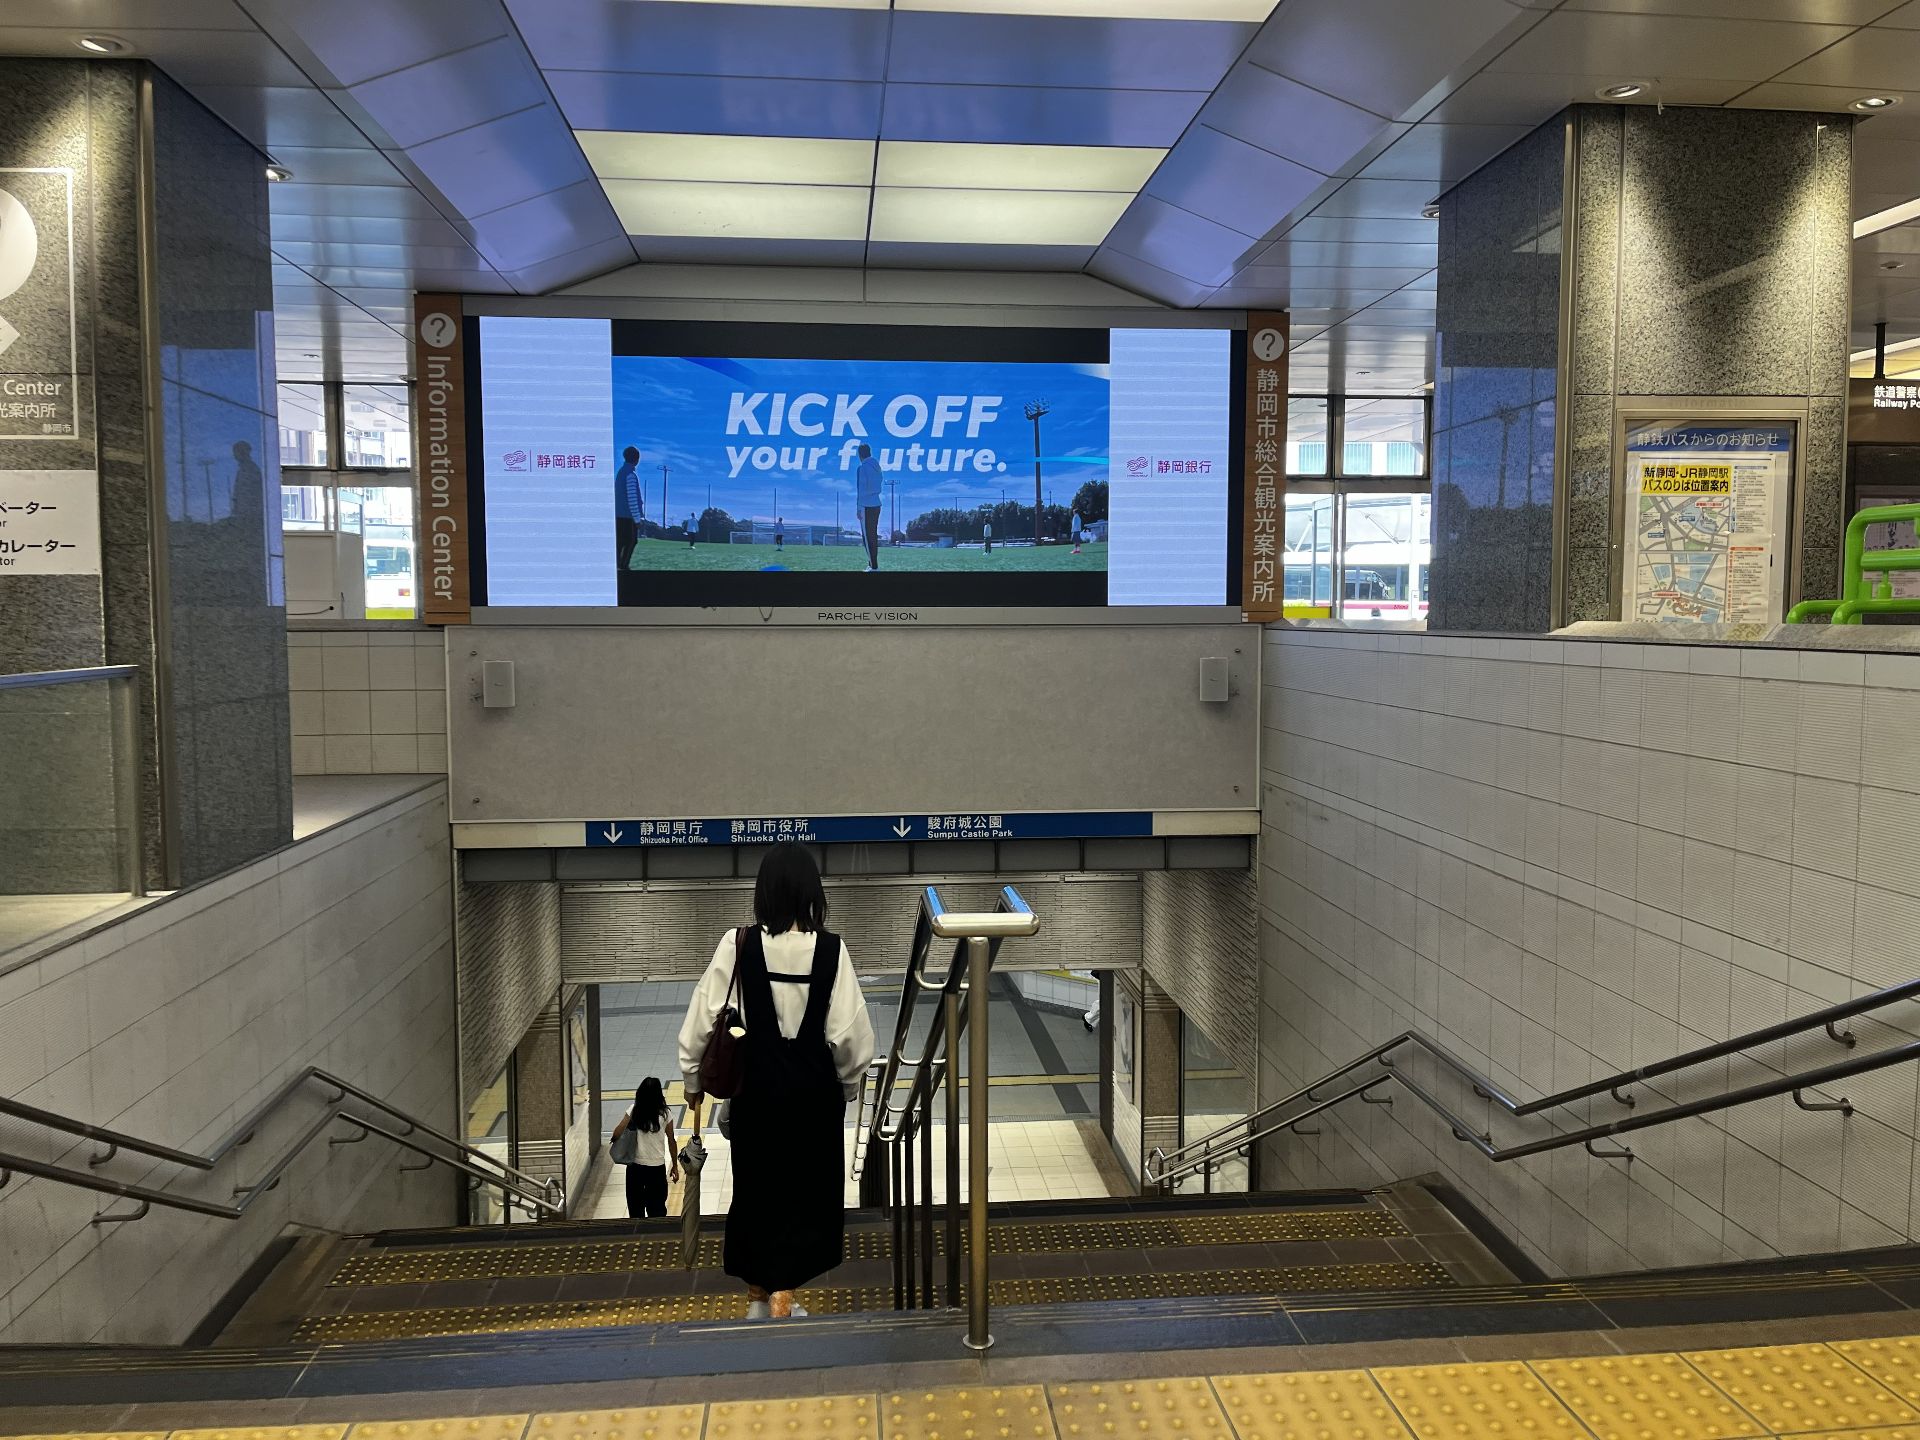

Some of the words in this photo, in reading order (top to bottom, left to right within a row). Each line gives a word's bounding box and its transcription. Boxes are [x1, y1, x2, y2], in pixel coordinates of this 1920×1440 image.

[3, 379, 62, 396] Center
[1874, 385, 1920, 399] 鉄道警察
[1873, 399, 1908, 410] Railway
[725, 392, 874, 437] KICK
[883, 394, 1003, 438] OFF
[427, 356, 454, 508] Information
[1637, 432, 1780, 447] 静鉄バスからのお知らせ
[537, 454, 596, 469] 静岡銀行
[725, 445, 828, 478] your
[1157, 460, 1212, 474] 静岡銀行
[1252, 368, 1280, 602] 静岡市総合観光案内所
[1643, 480, 1729, 492] バスのりば位置案内
[432, 515, 457, 600] Center
[818, 612, 870, 620] PARCHE
[874, 612, 918, 620] VISION
[640, 821, 703, 836] 静岡県庁
[730, 819, 809, 834] 静岡市役所
[927, 816, 1002, 830] 駿府城公園
[640, 835, 670, 844] Shizuoka
[671, 835, 687, 844] Pref.
[688, 835, 708, 843] Office
[731, 834, 774, 843] Shizuoka
[777, 833, 795, 842] City
[798, 833, 816, 841] Hall
[927, 830, 958, 839] Sumpu
[961, 830, 989, 838] Castle
[992, 829, 1013, 837] Park
